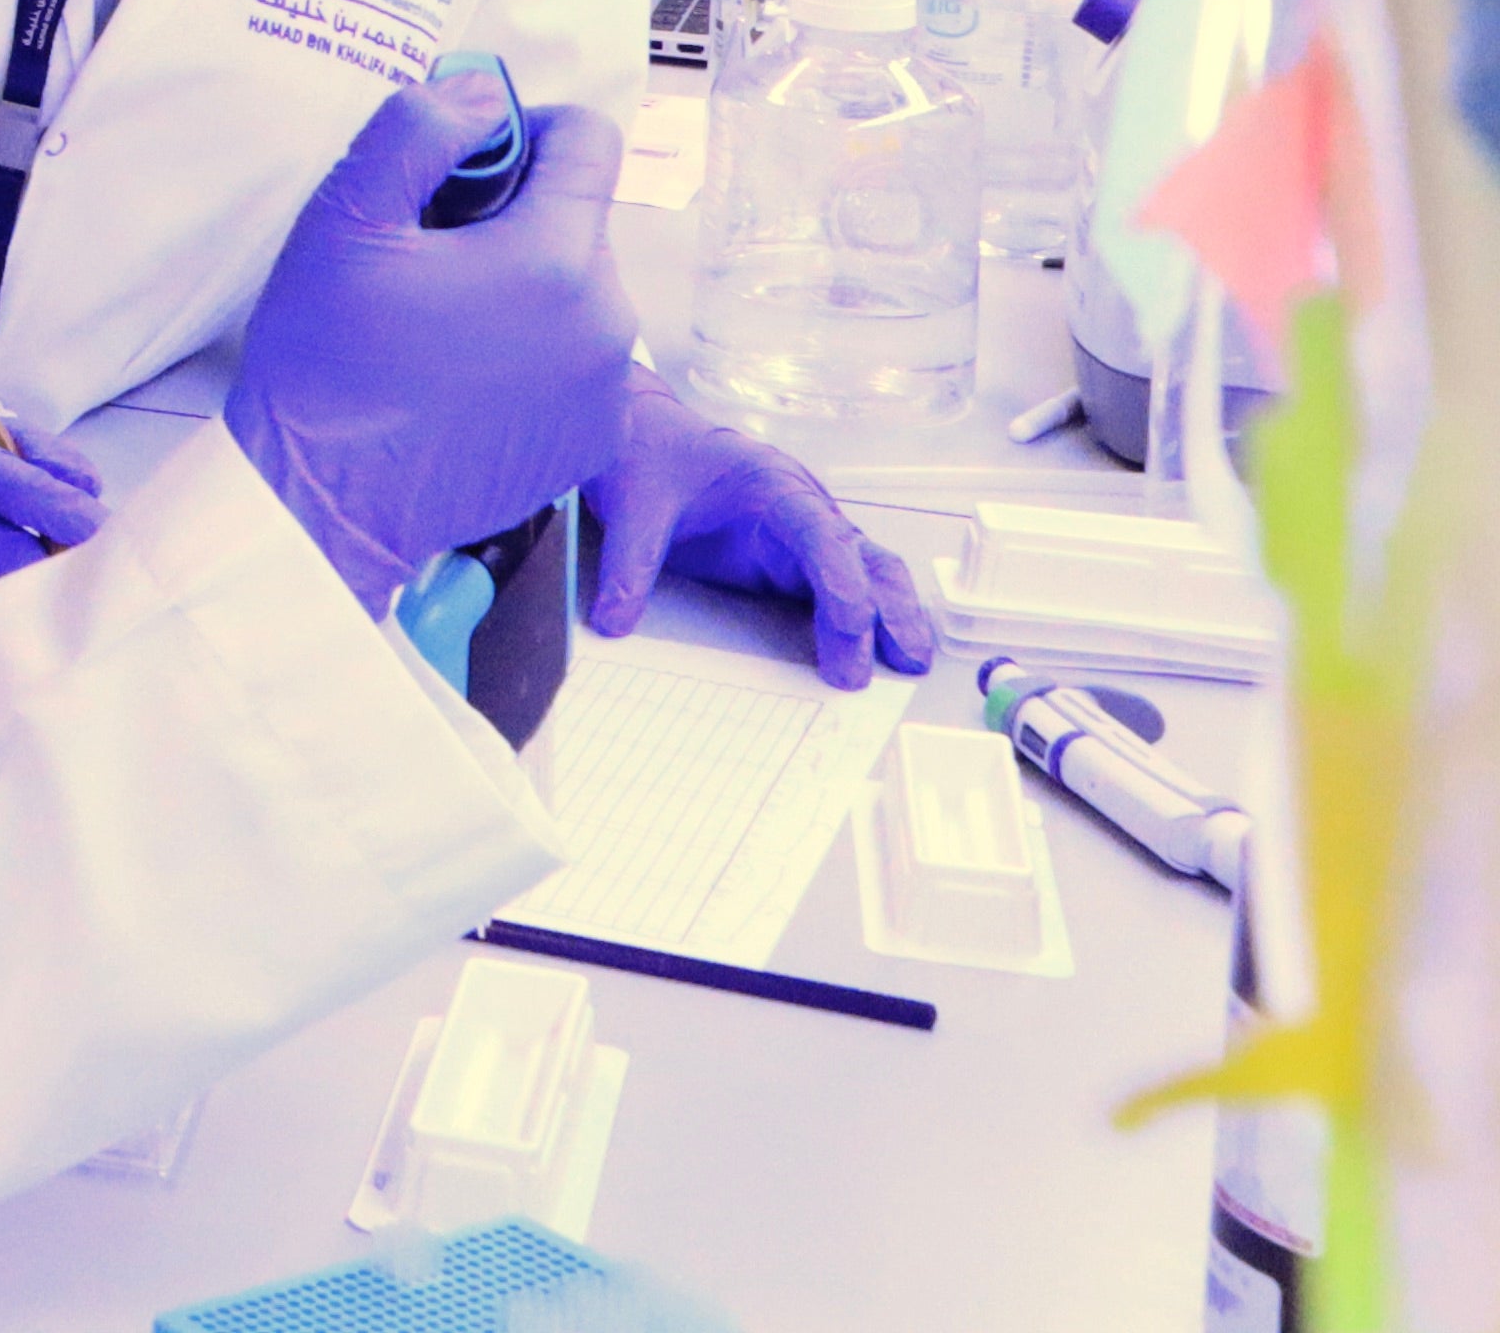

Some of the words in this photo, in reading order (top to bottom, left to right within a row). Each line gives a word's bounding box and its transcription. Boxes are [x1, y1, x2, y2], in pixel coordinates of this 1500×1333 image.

[333, 9, 359, 38] بن
[249, 15, 303, 44] HAMAD
[306, 33, 332, 55] BIN
[337, 43, 386, 76] KHALIFA
[362, 27, 398, 51] حمد
